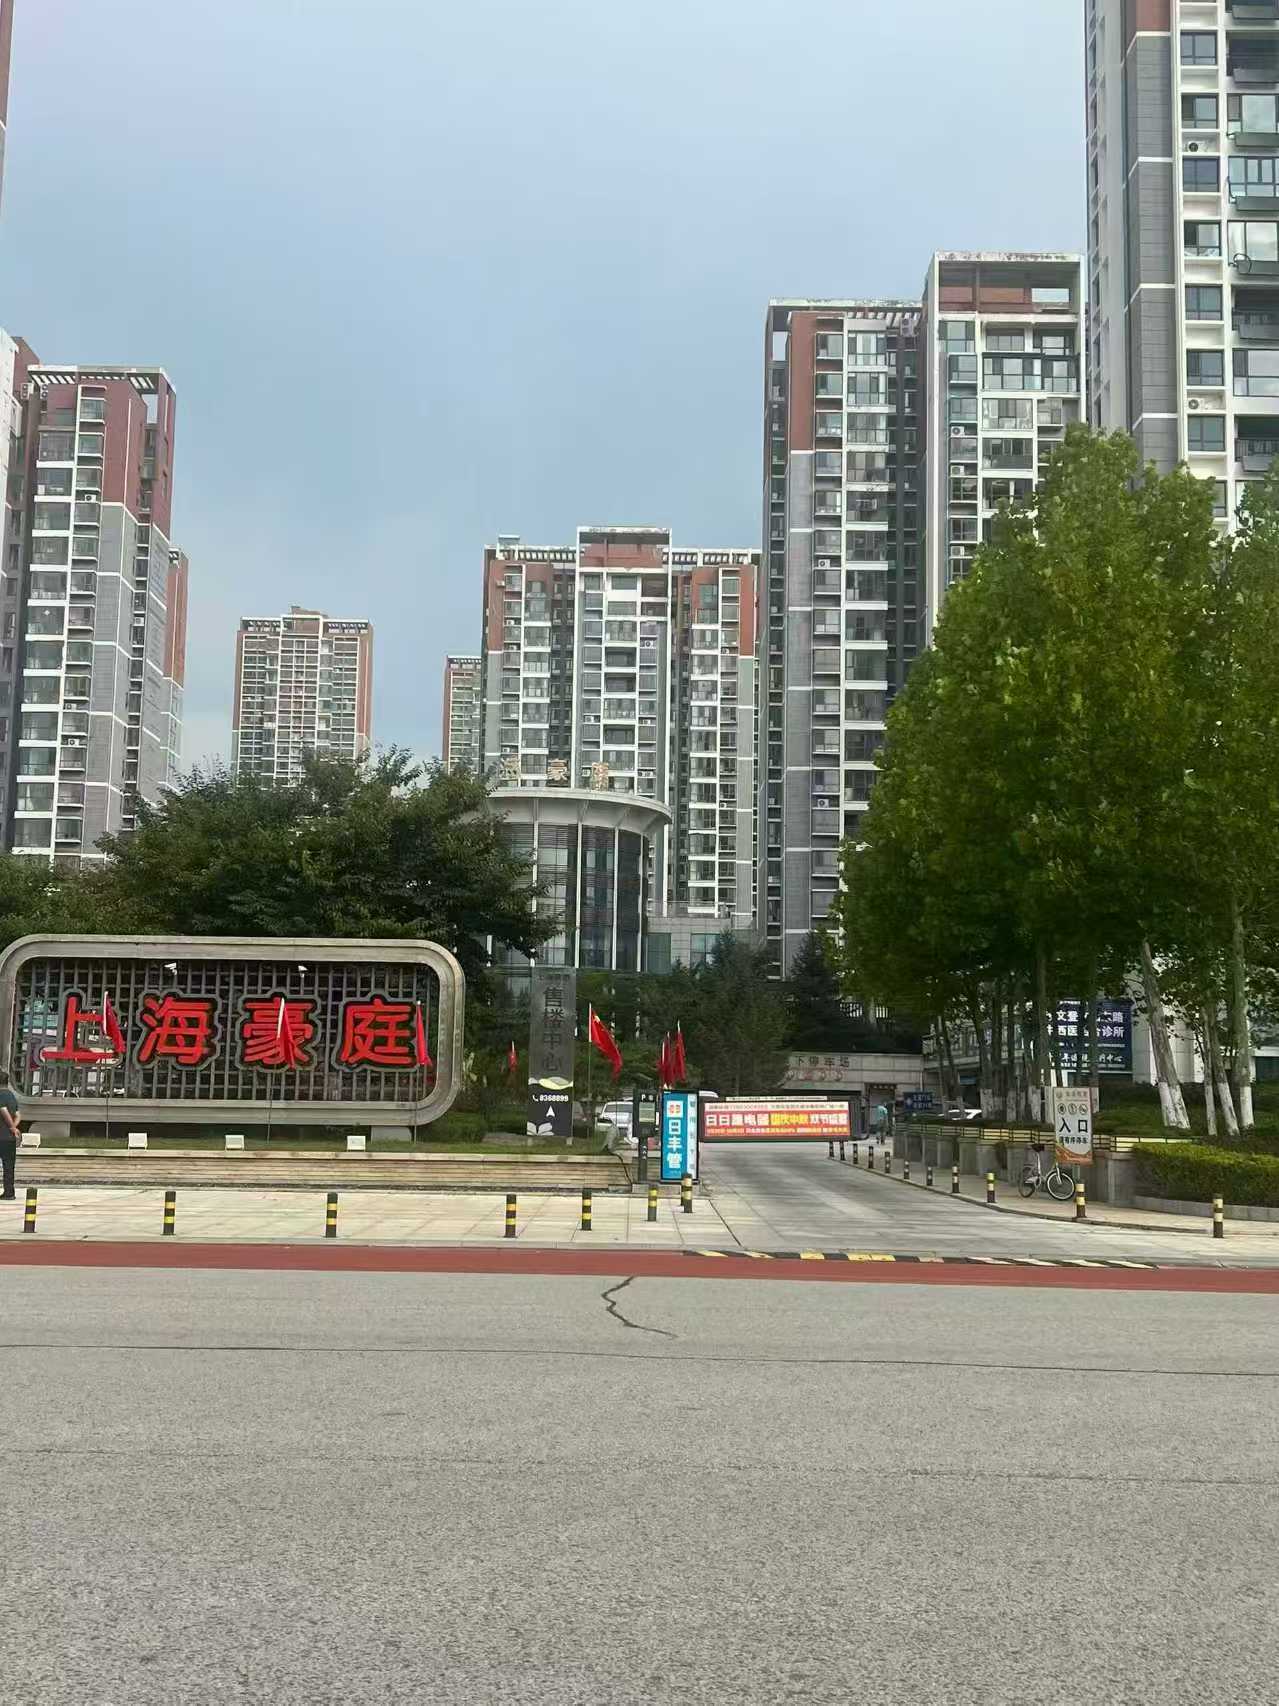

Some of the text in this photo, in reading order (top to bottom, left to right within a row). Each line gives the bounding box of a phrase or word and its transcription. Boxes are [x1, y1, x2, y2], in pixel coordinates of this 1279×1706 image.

[41, 995, 414, 1065] 上海豪庭
[543, 987, 564, 1071] 售楼中心
[667, 1119, 682, 1168] 日丰管
[1059, 1117, 1088, 1133] 入口
